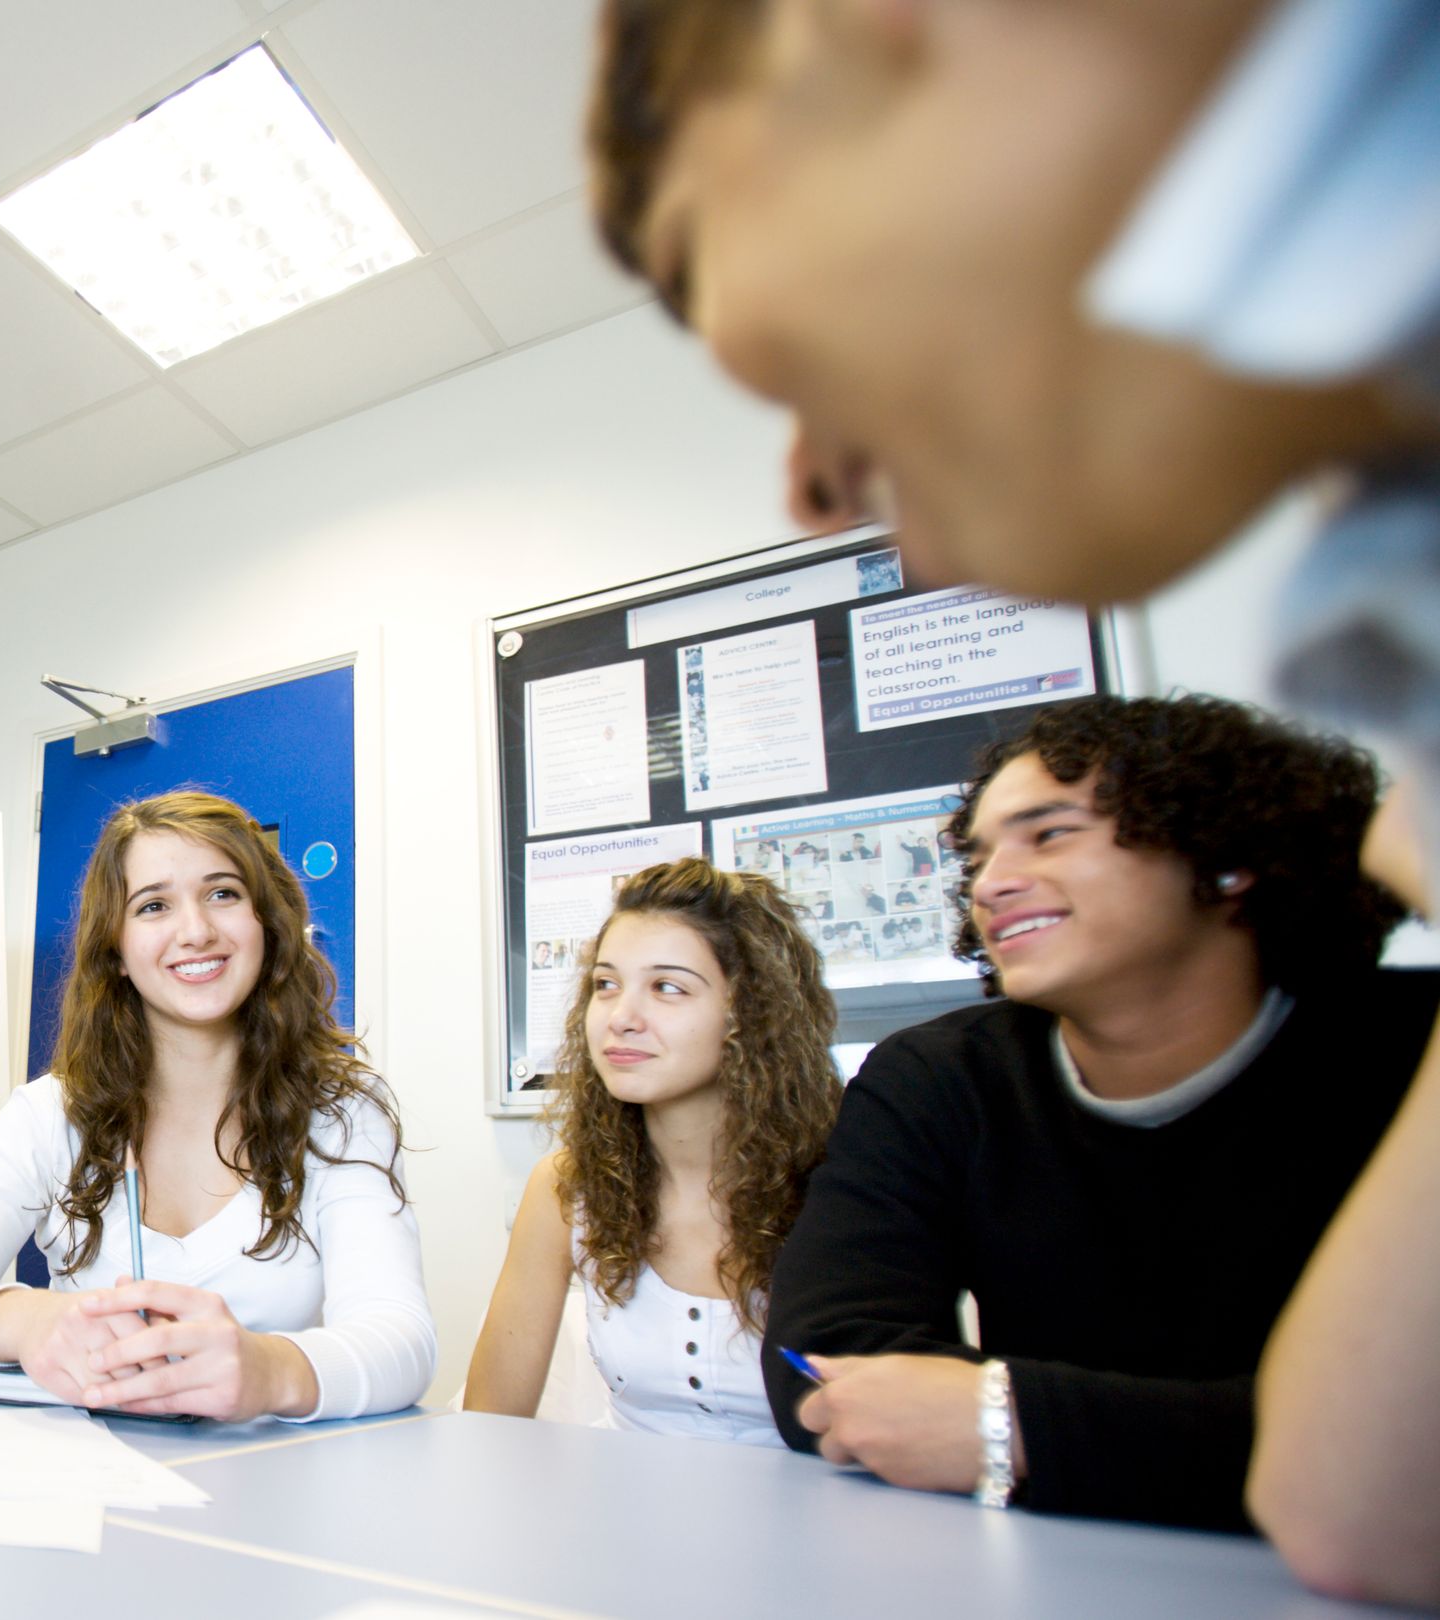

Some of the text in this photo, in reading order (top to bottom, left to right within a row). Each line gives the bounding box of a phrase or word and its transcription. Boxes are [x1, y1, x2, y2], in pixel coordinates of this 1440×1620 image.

[745, 583, 792, 603] College
[863, 614, 875, 623] To
[878, 609, 905, 621] meet
[907, 604, 923, 616] the
[926, 597, 959, 611] needs
[961, 593, 972, 604] of
[975, 592, 988, 602] all
[863, 599, 1056, 643] English is the languag
[718, 639, 778, 657] ADVICE CENTRE
[864, 620, 1024, 662] of all learning and
[865, 644, 998, 680] teaching in the
[867, 673, 962, 698] classroom.
[872, 681, 1029, 719] Equal Opportunities
[761, 822, 791, 834] Active
[793, 815, 835, 831] Learning
[844, 810, 875, 823] Maths
[877, 807, 886, 818] &
[889, 801, 943, 816] Numeracy
[531, 836, 660, 861] Equal Opportunities
